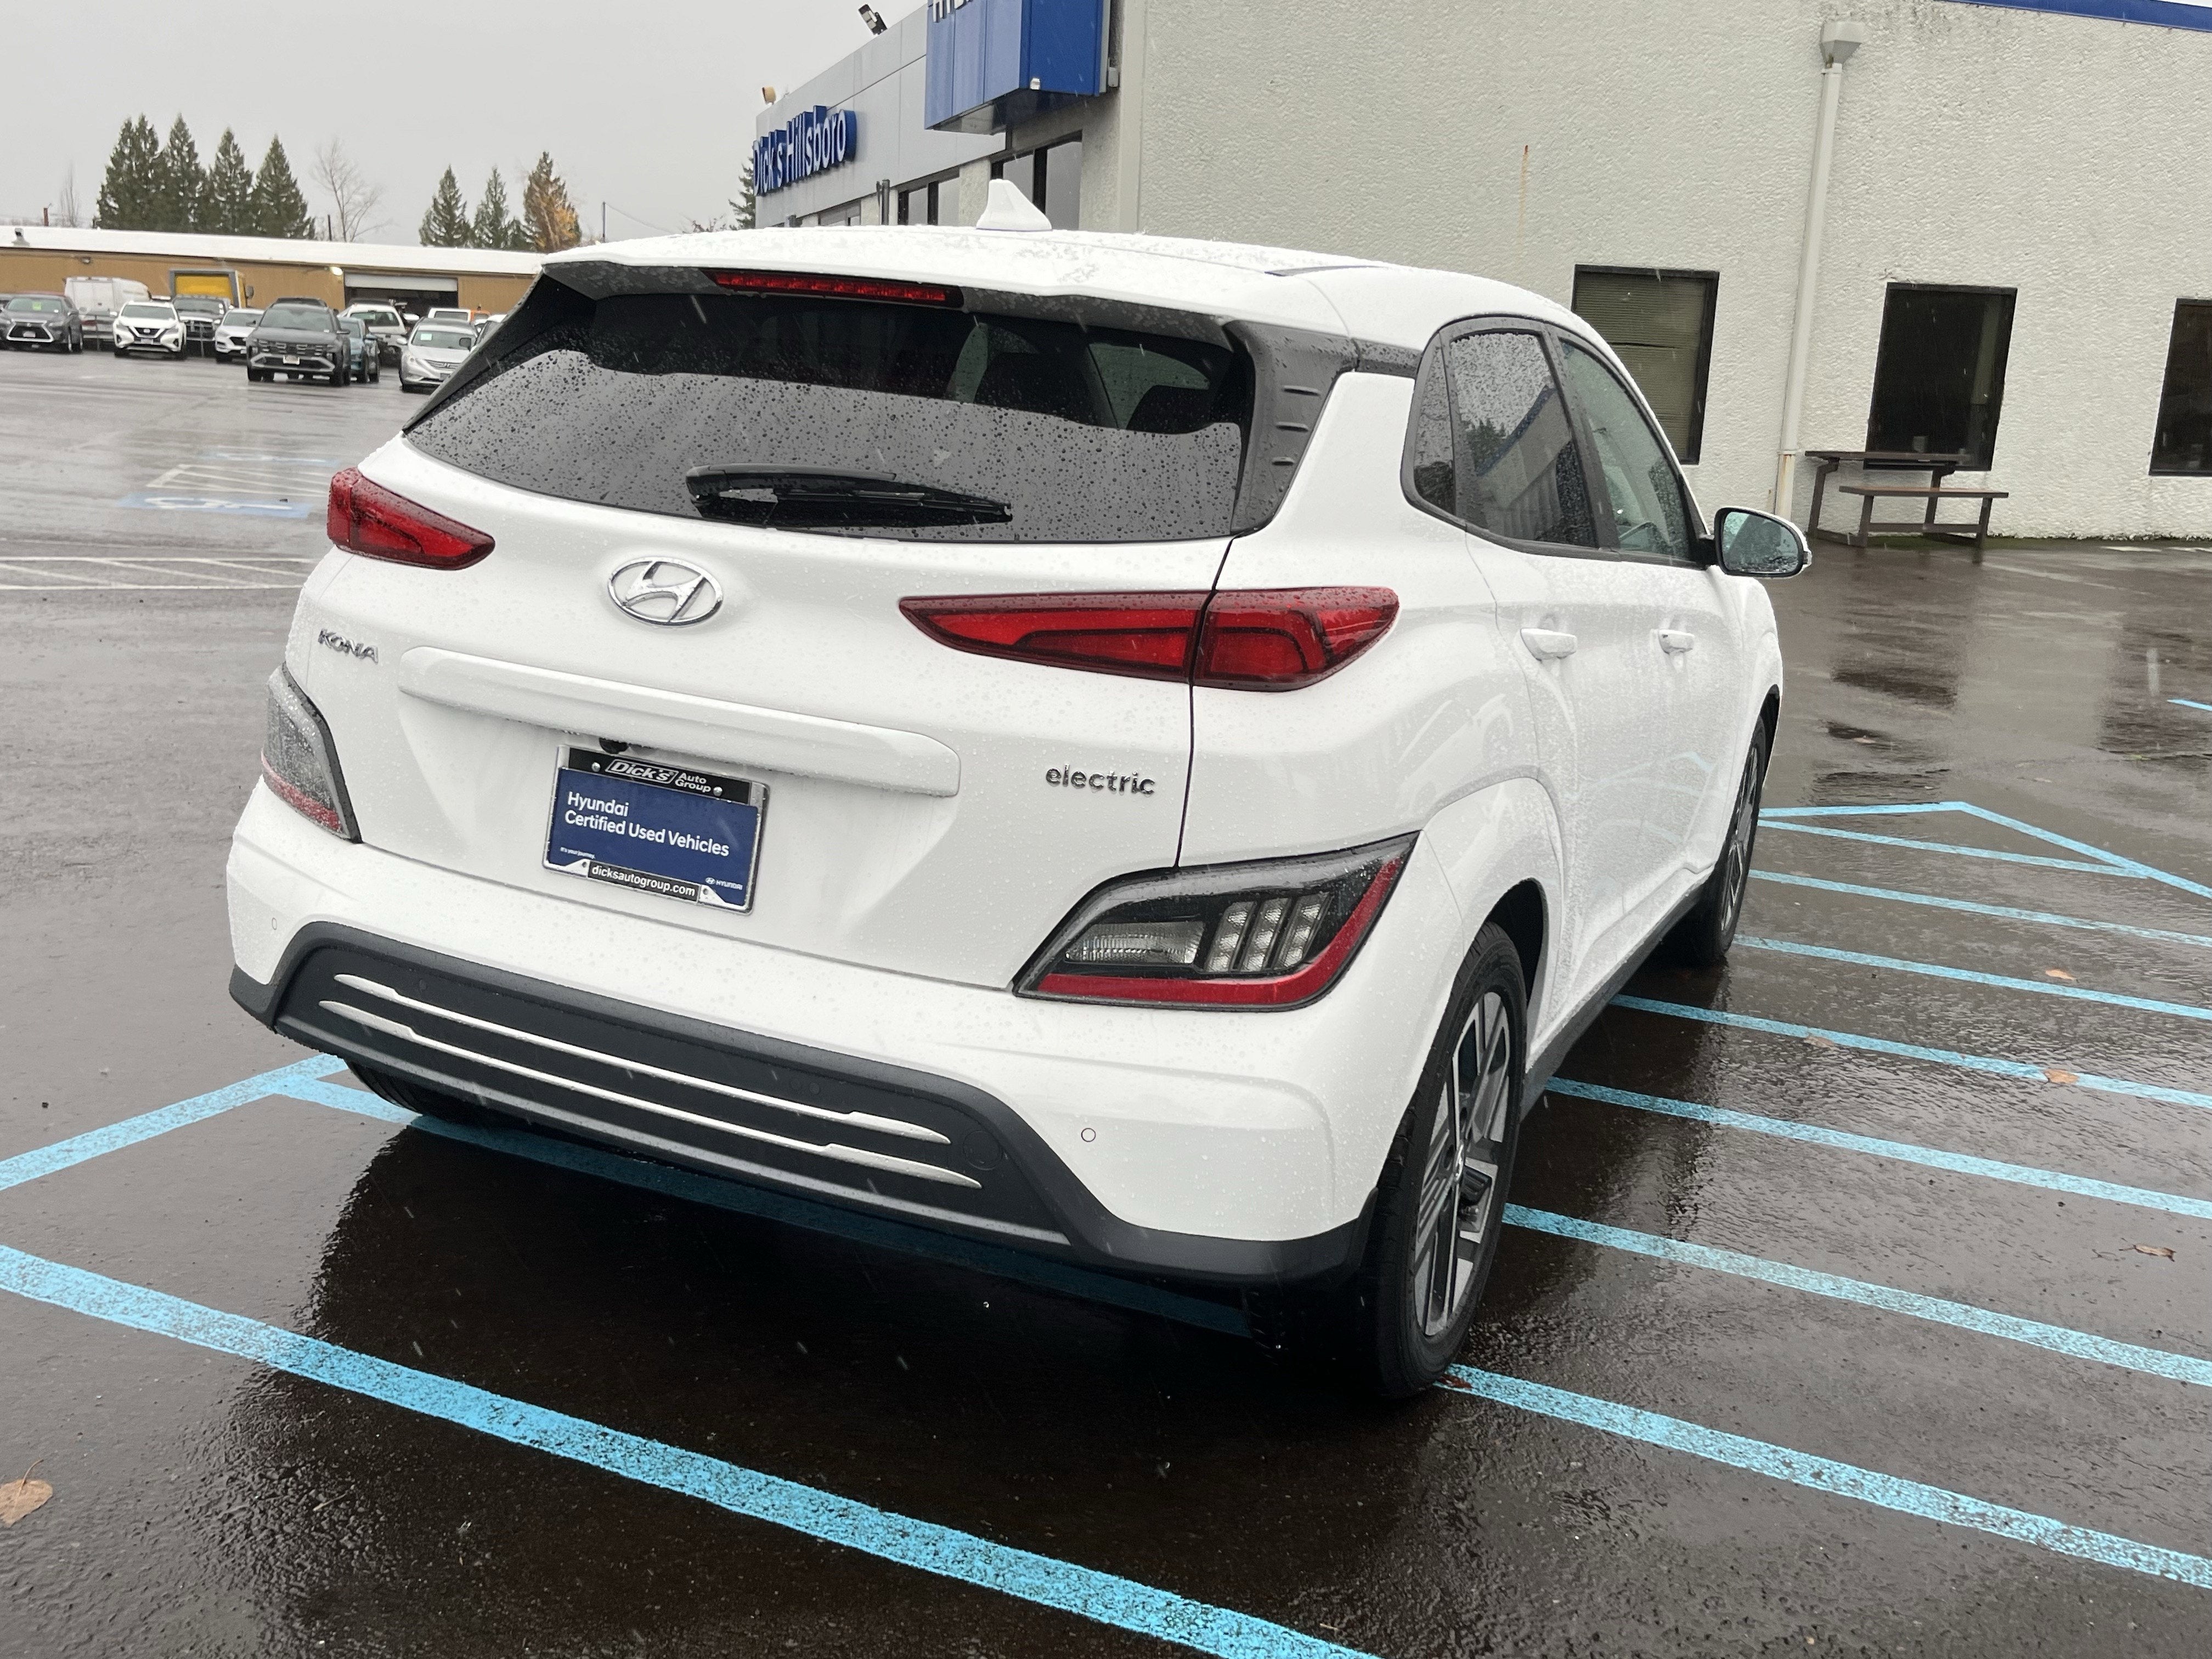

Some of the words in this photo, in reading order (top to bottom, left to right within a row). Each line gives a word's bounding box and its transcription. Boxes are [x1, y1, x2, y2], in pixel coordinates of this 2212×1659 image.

[753, 129, 783, 196] Dick's
[786, 105, 847, 183] Hillsboro
[318, 628, 379, 664] KONA
[611, 761, 670, 781] Dick's
[678, 772, 707, 785] Auto
[675, 778, 712, 793] Group
[1046, 764, 1155, 796] electric
[567, 791, 629, 817] Hyundai
[565, 809, 627, 835] Certified
[628, 822, 666, 843] Used
[668, 830, 730, 857] Vehicles
[591, 865, 696, 896] dicksautogroup.com
